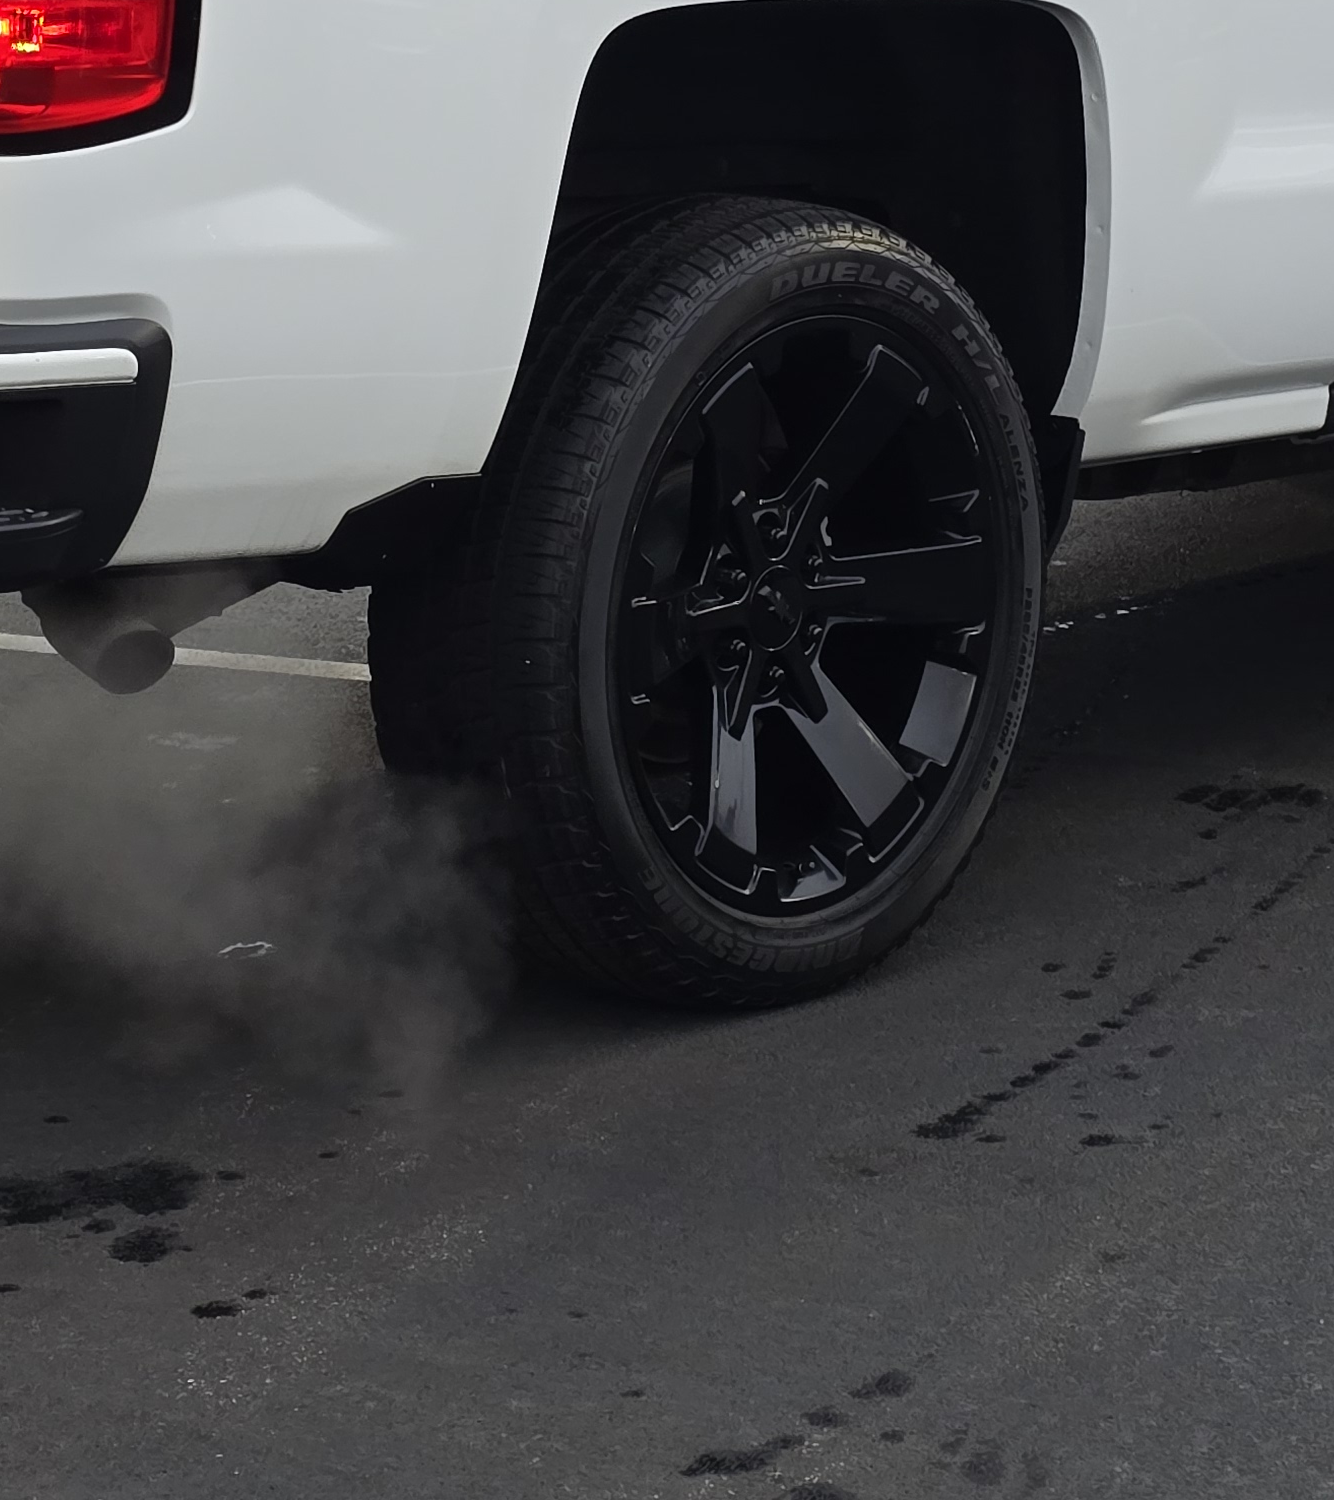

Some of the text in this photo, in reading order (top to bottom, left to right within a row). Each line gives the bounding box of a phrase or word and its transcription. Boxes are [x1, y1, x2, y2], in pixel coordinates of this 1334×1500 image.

[769, 260, 941, 315] DUELER
[951, 323, 1002, 406] H/L
[999, 413, 1030, 512] ALENZA
